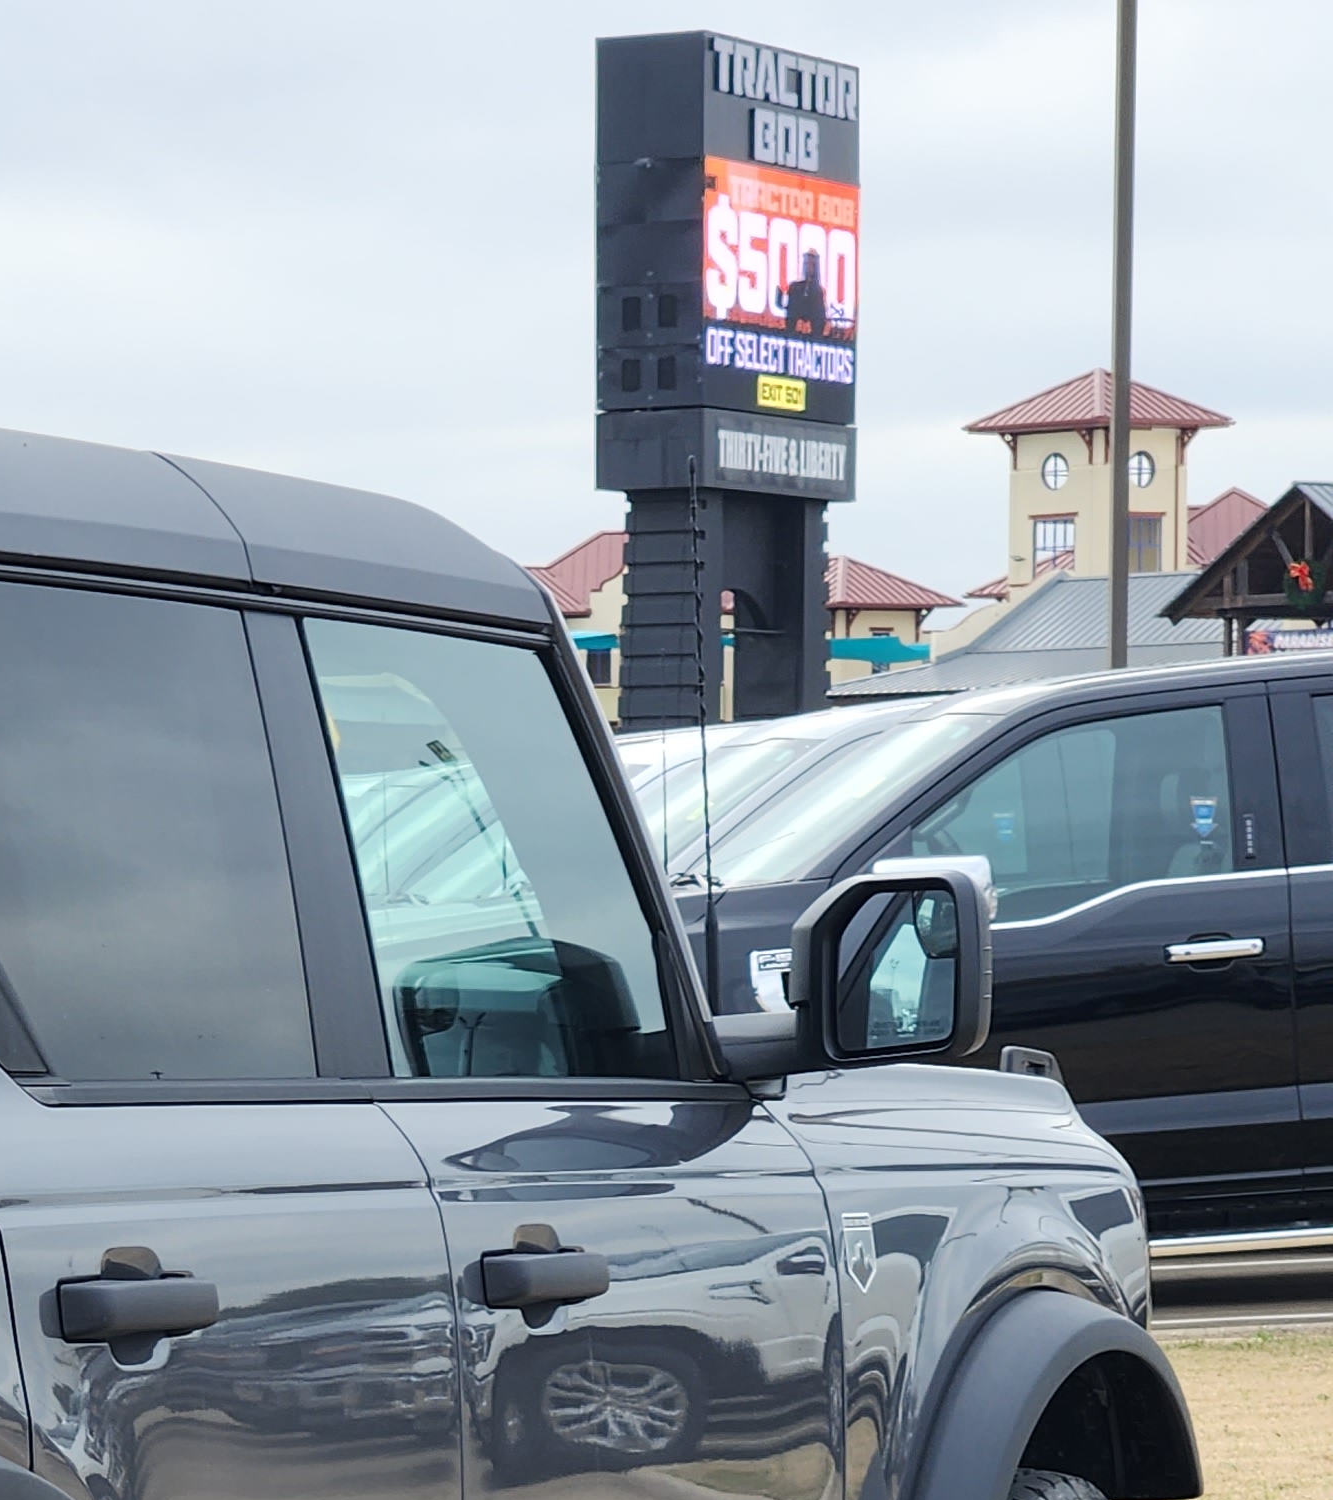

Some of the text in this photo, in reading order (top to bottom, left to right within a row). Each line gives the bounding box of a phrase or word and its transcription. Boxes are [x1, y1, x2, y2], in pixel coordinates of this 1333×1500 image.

[714, 37, 857, 121] TRACTOR
[754, 107, 819, 172] BOB
[730, 175, 855, 228] TRACTOR BOB
[706, 327, 855, 385] OFF SELECT TRACTORS
[761, 383, 783, 401] EXIT
[718, 429, 847, 481] THIRTY-FIVE & LIBERTY
